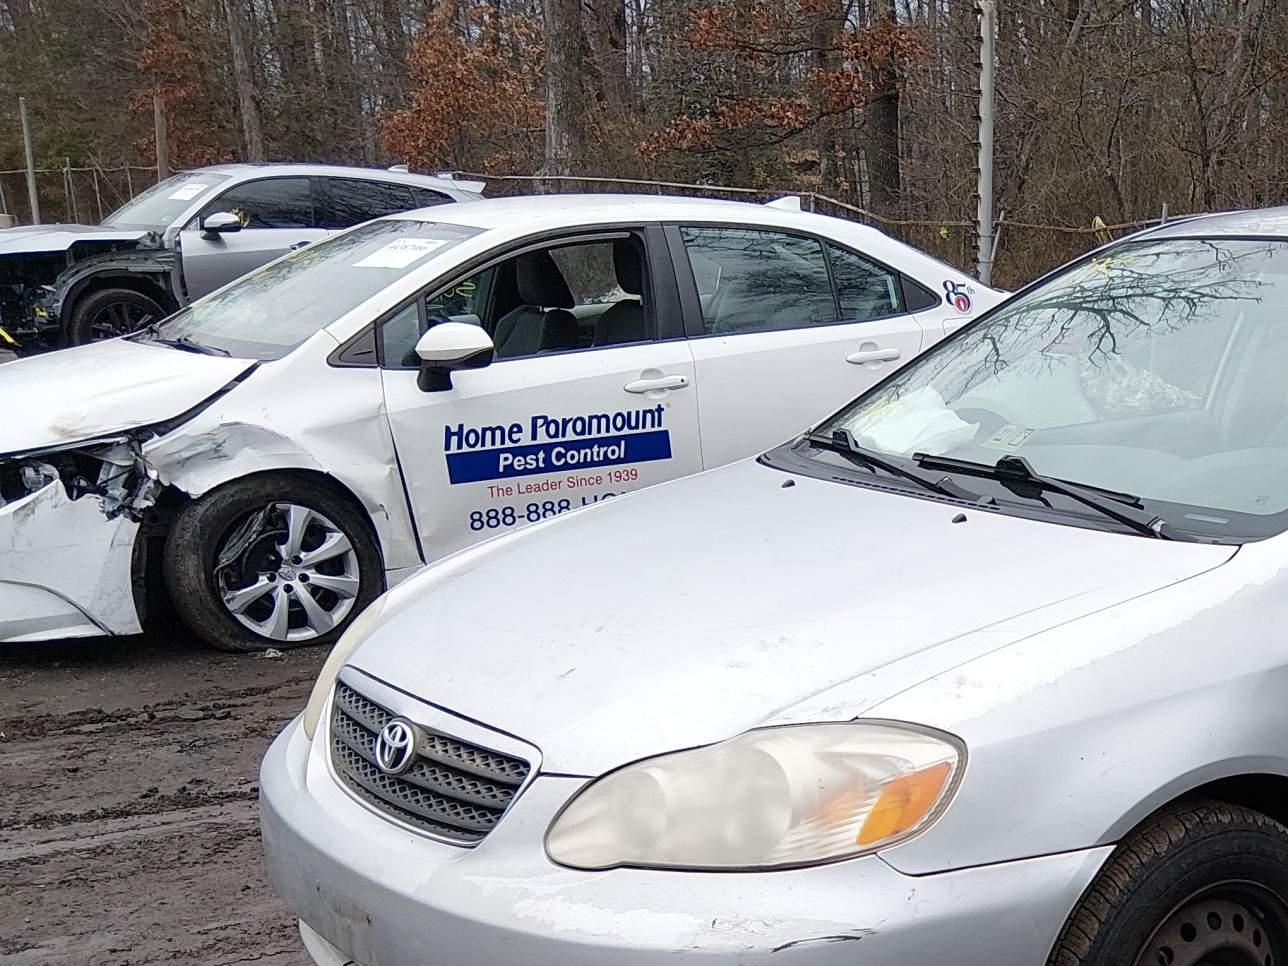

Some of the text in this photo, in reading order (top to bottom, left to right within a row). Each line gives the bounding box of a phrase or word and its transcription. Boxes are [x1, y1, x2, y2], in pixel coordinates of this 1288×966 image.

[444, 403, 665, 452] Home Paramount
[498, 440, 625, 473] Pest Control
[488, 467, 639, 499] The Leader Since 1939
